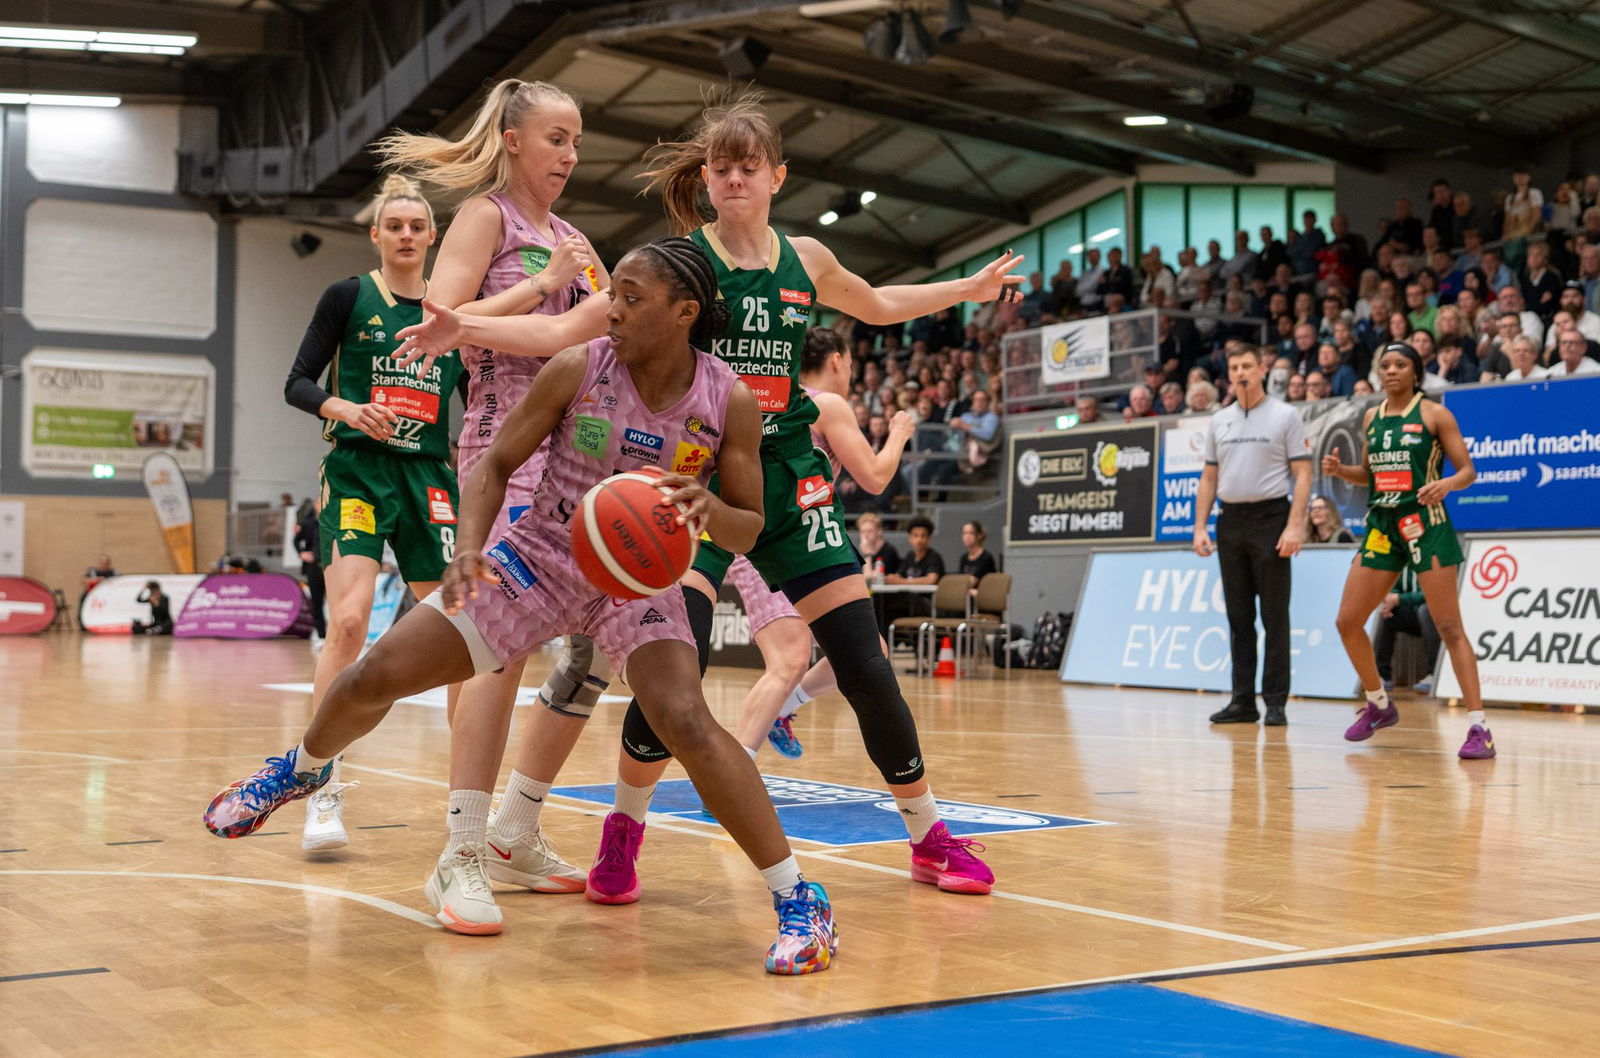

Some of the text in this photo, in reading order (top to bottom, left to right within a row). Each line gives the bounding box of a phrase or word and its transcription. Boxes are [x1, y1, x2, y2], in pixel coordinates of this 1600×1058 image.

[742, 296, 770, 332] 25
[711, 338, 792, 360] KLEINER
[730, 361, 790, 377] nztechnik
[371, 373, 441, 395] Stanztechnik
[389, 396, 421, 407] Sparkasse
[770, 400, 785, 409] Calw
[420, 411, 435, 420] Calw
[478, 393, 497, 437] ROYALS
[394, 416, 425, 441] PZ
[629, 431, 656, 446] HYLO
[1382, 429, 1393, 450] 5
[387, 437, 420, 450] medien
[578, 434, 600, 451] Steel
[1464, 432, 1536, 459] Zukunft
[1041, 459, 1060, 473] DIE
[1368, 450, 1411, 464] KLEINER
[1163, 477, 1199, 499] WIR
[1037, 489, 1118, 512] TEAMGEIST
[1162, 501, 1191, 521] AM
[801, 506, 843, 553] 25
[1028, 510, 1124, 534] SIEGT IMMER!
[1408, 538, 1422, 565] 5
[1504, 587, 1600, 619] CASIN
[640, 617, 668, 627] PEAK
[1121, 625, 1190, 669] EYE
